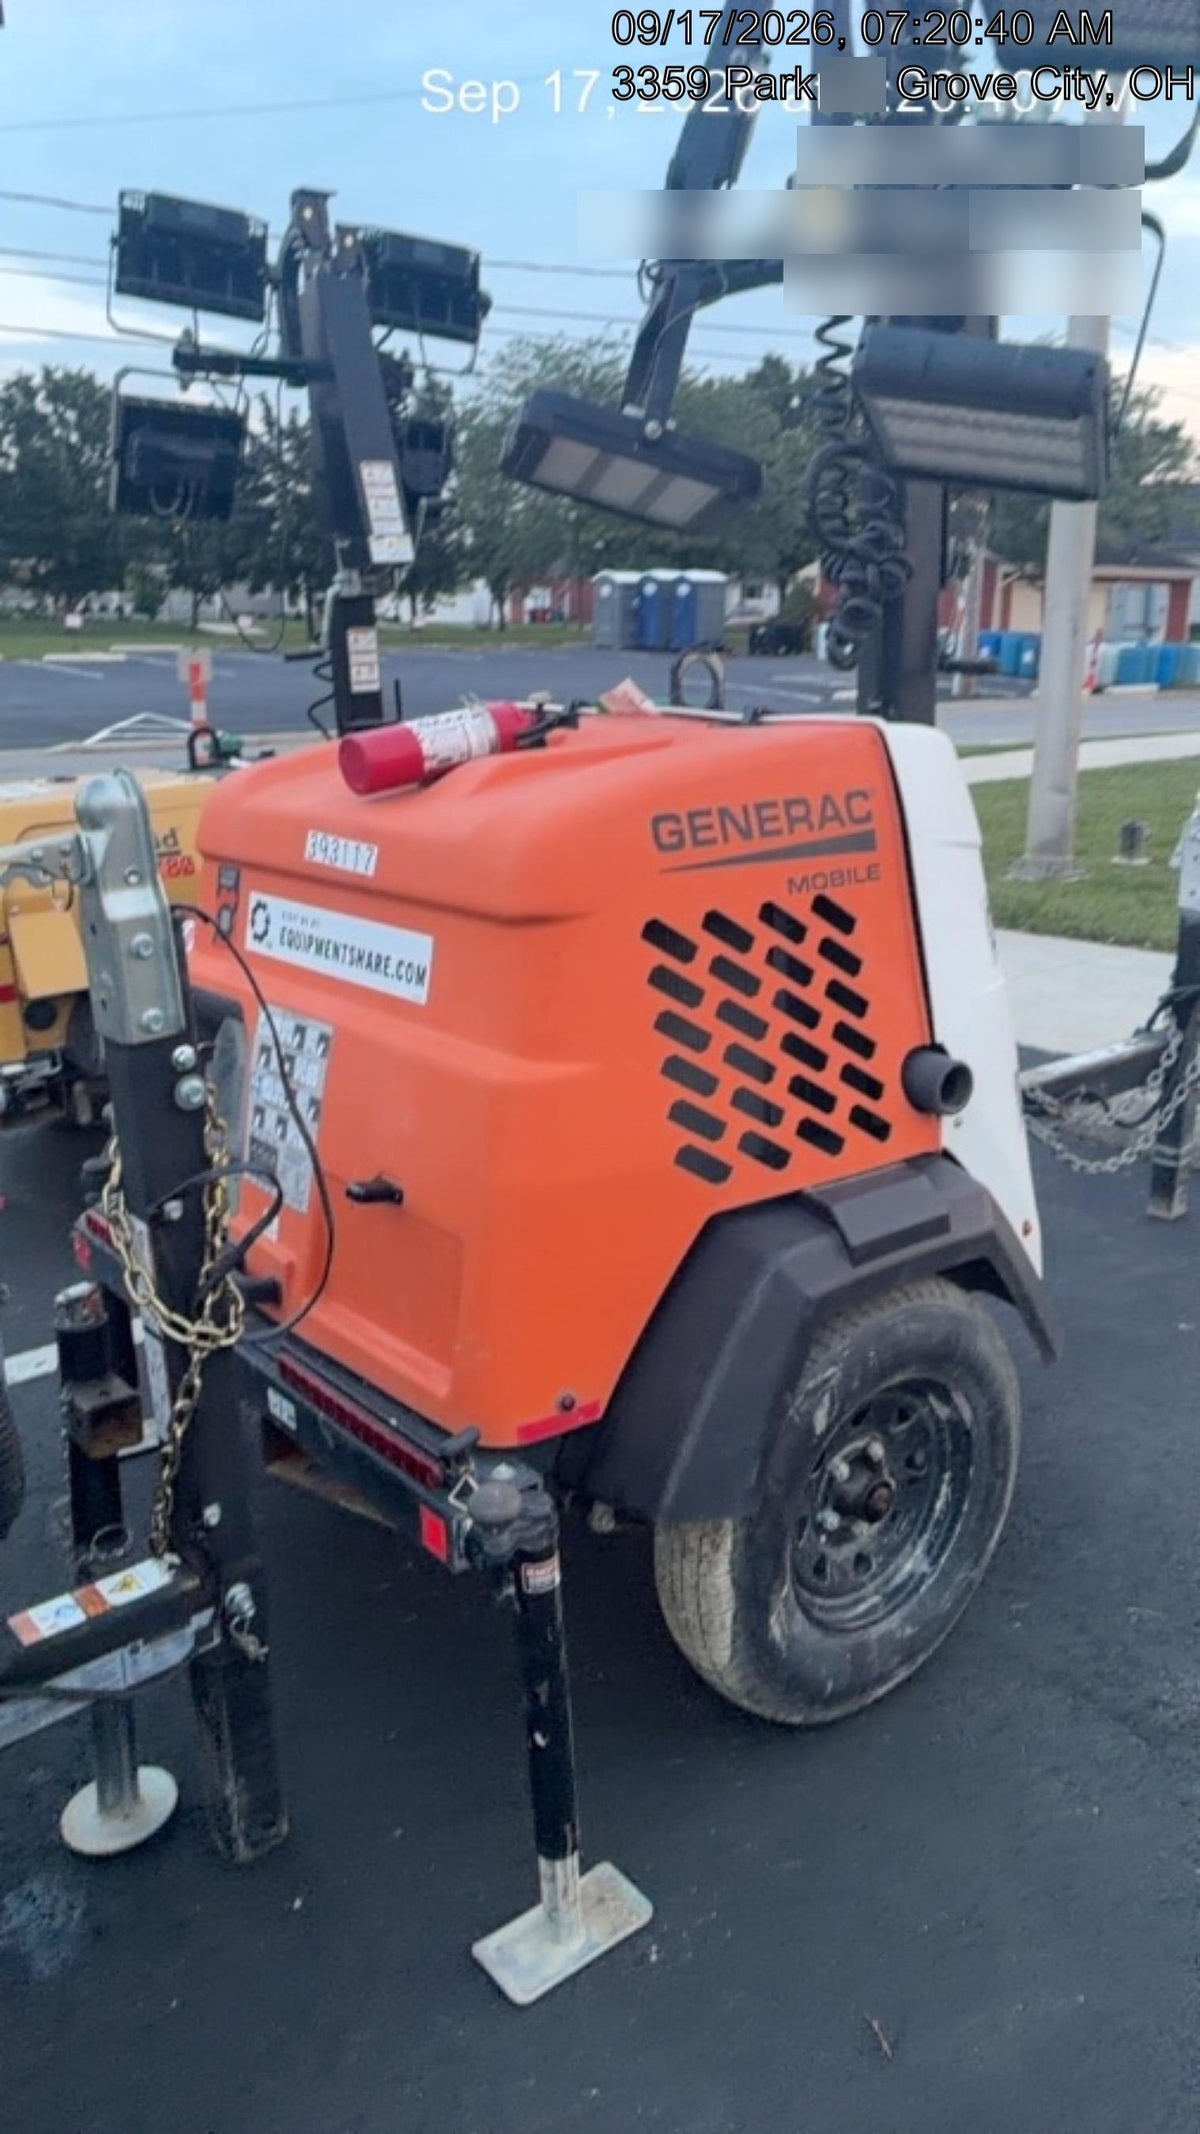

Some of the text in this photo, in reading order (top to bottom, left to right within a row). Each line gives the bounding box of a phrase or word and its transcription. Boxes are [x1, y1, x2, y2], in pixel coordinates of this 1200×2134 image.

[650, 789, 874, 853] GENERAC
[787, 863, 881, 895] MOBILE
[280, 926, 428, 987] EQUIPMENTSHARE.COM
